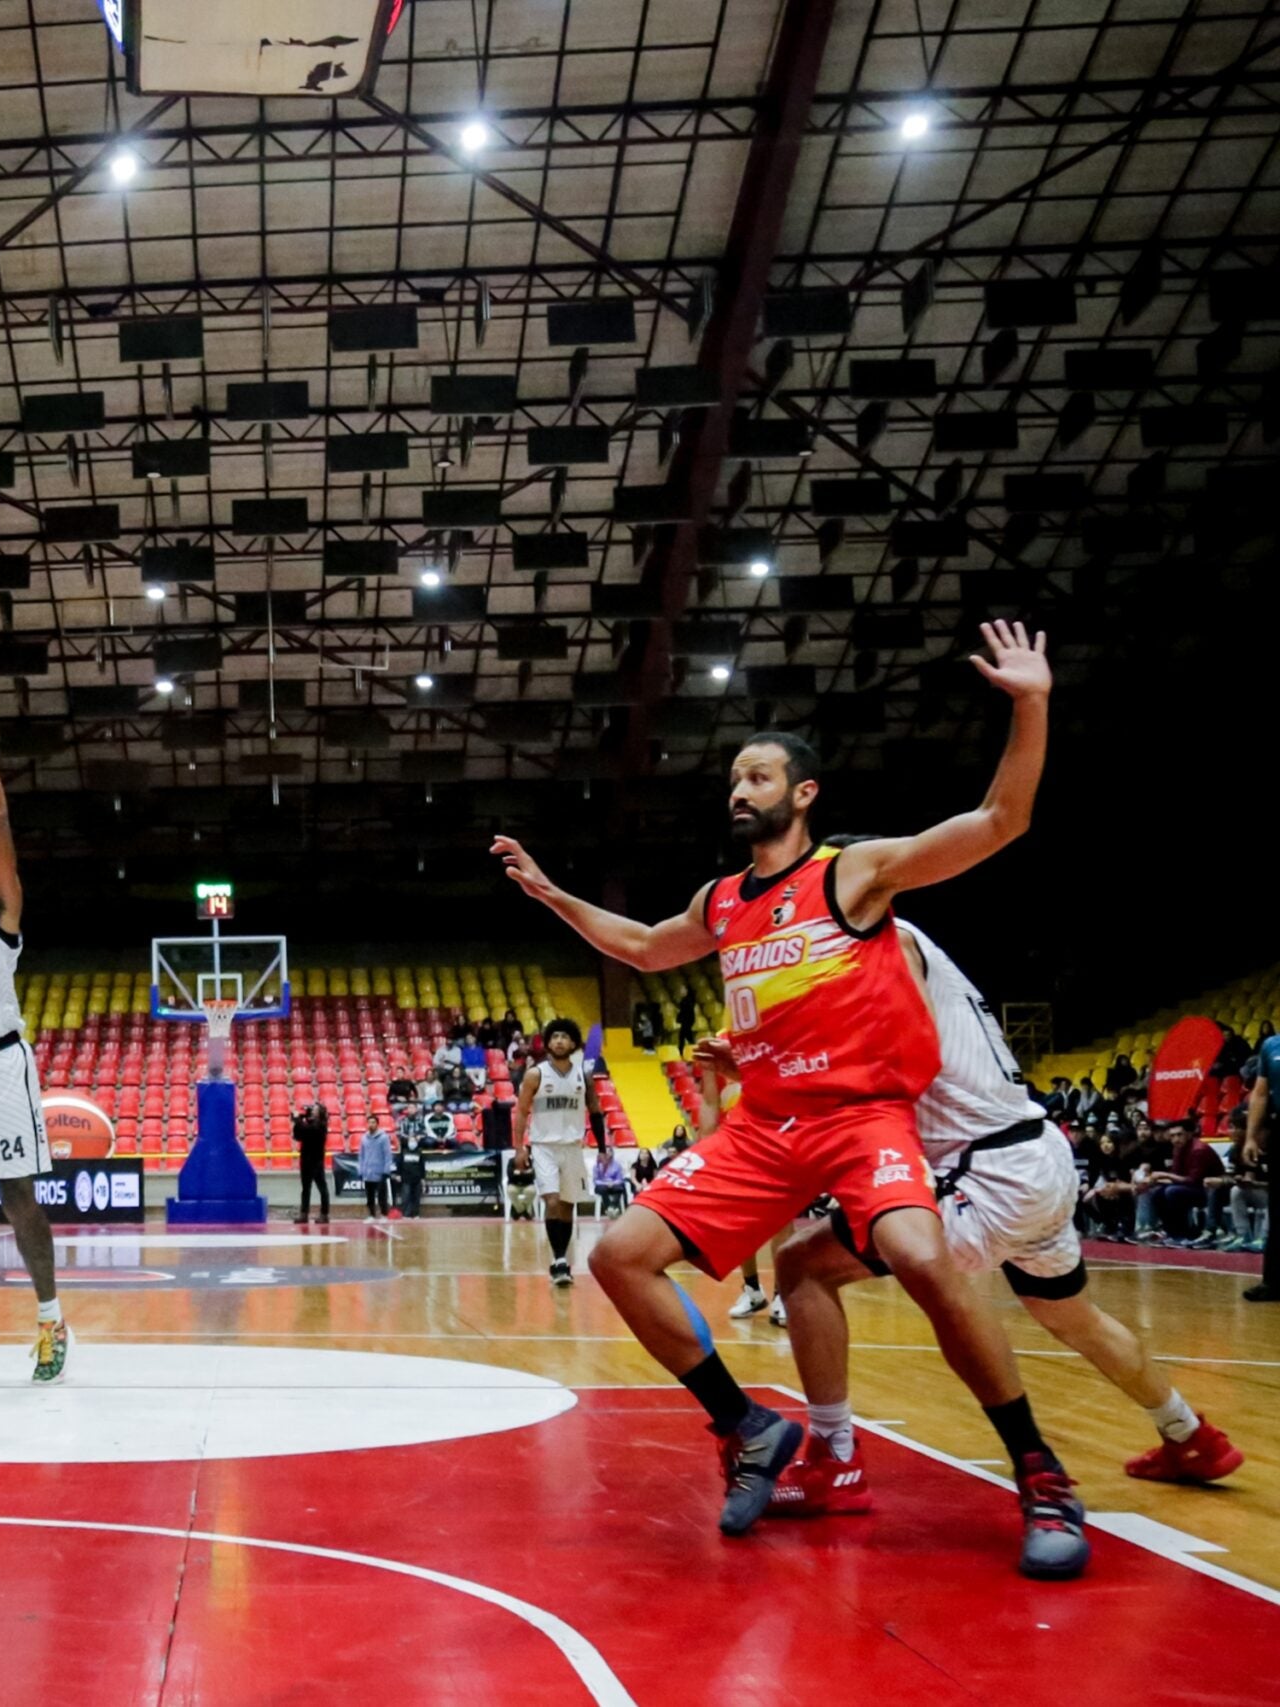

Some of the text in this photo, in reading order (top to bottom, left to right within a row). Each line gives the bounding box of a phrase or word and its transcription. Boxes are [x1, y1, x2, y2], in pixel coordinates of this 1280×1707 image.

[209, 896, 227, 914] 14
[721, 937, 805, 977] SARIOS
[730, 986, 759, 1032] 10
[779, 1051, 830, 1078] salud
[46, 1112, 92, 1131] olten
[0, 1136, 25, 1161] 24
